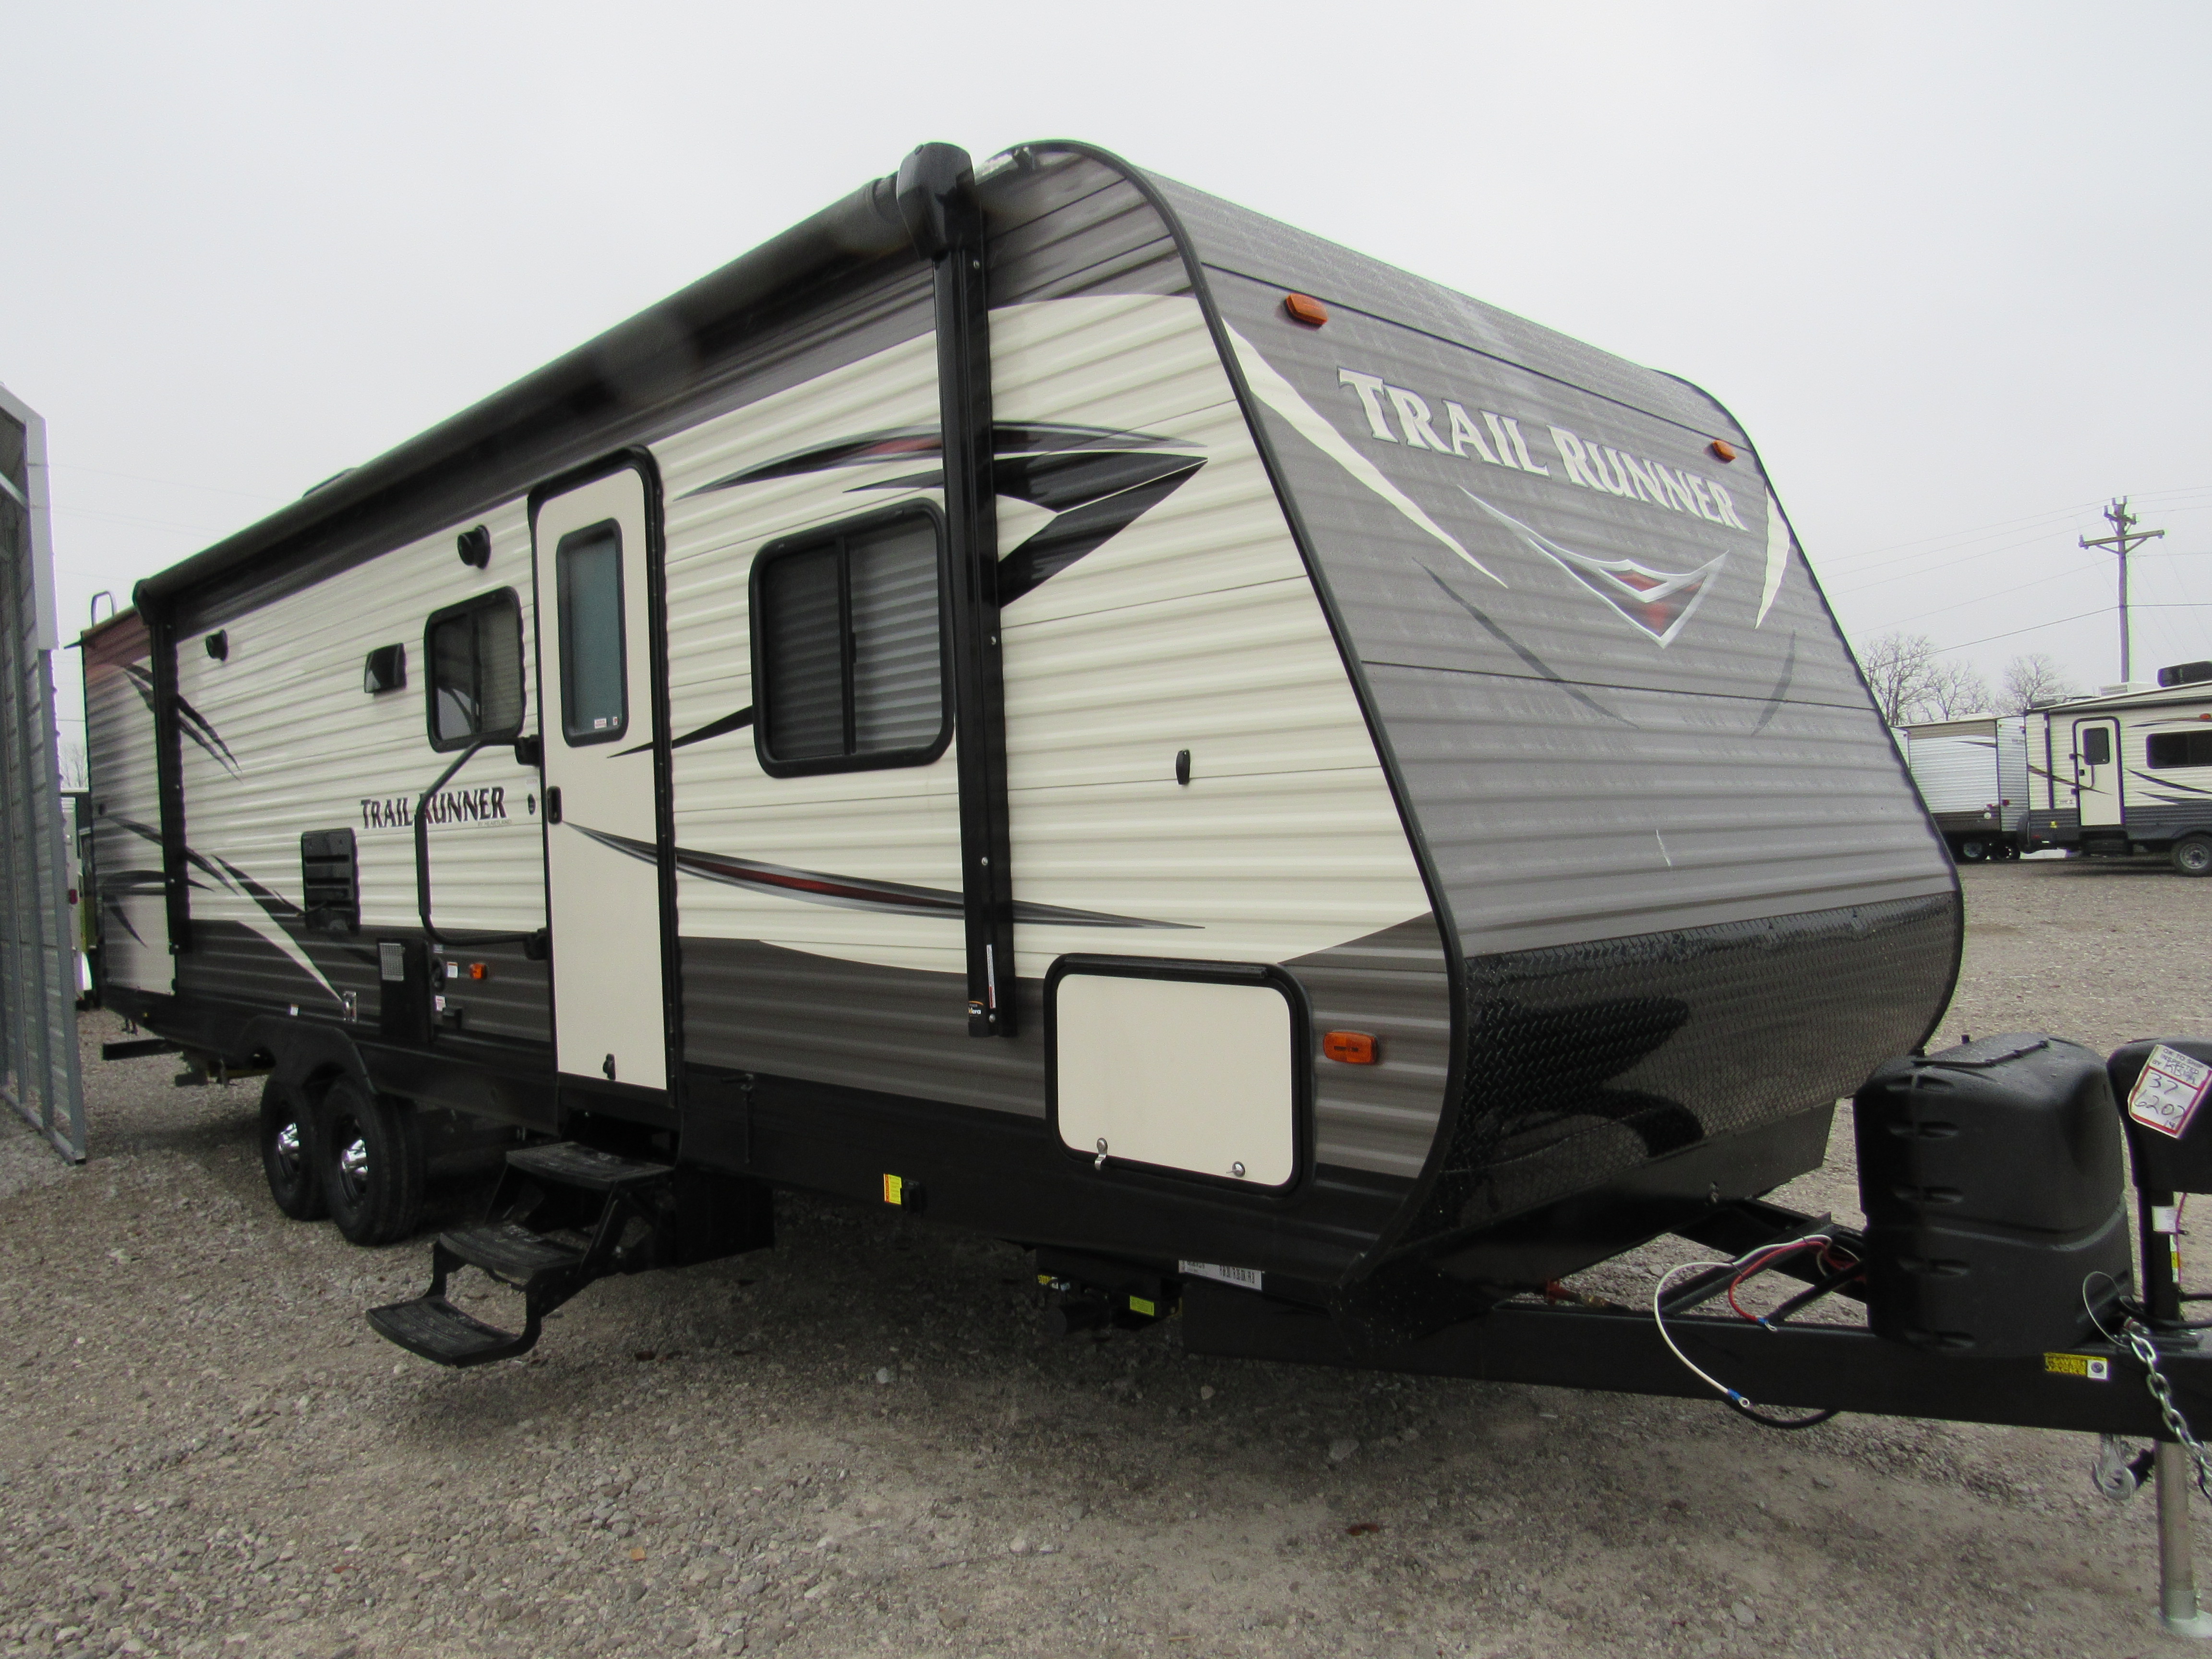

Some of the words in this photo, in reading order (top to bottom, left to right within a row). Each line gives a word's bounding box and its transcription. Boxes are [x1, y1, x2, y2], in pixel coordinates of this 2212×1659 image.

[1338, 368, 1551, 479] TRAIL
[1547, 424, 1750, 532] RUNNER
[361, 797, 414, 829] TRAIL
[2161, 1054, 2200, 1074] INSPECTED
[2148, 1072, 2178, 1094] 37
